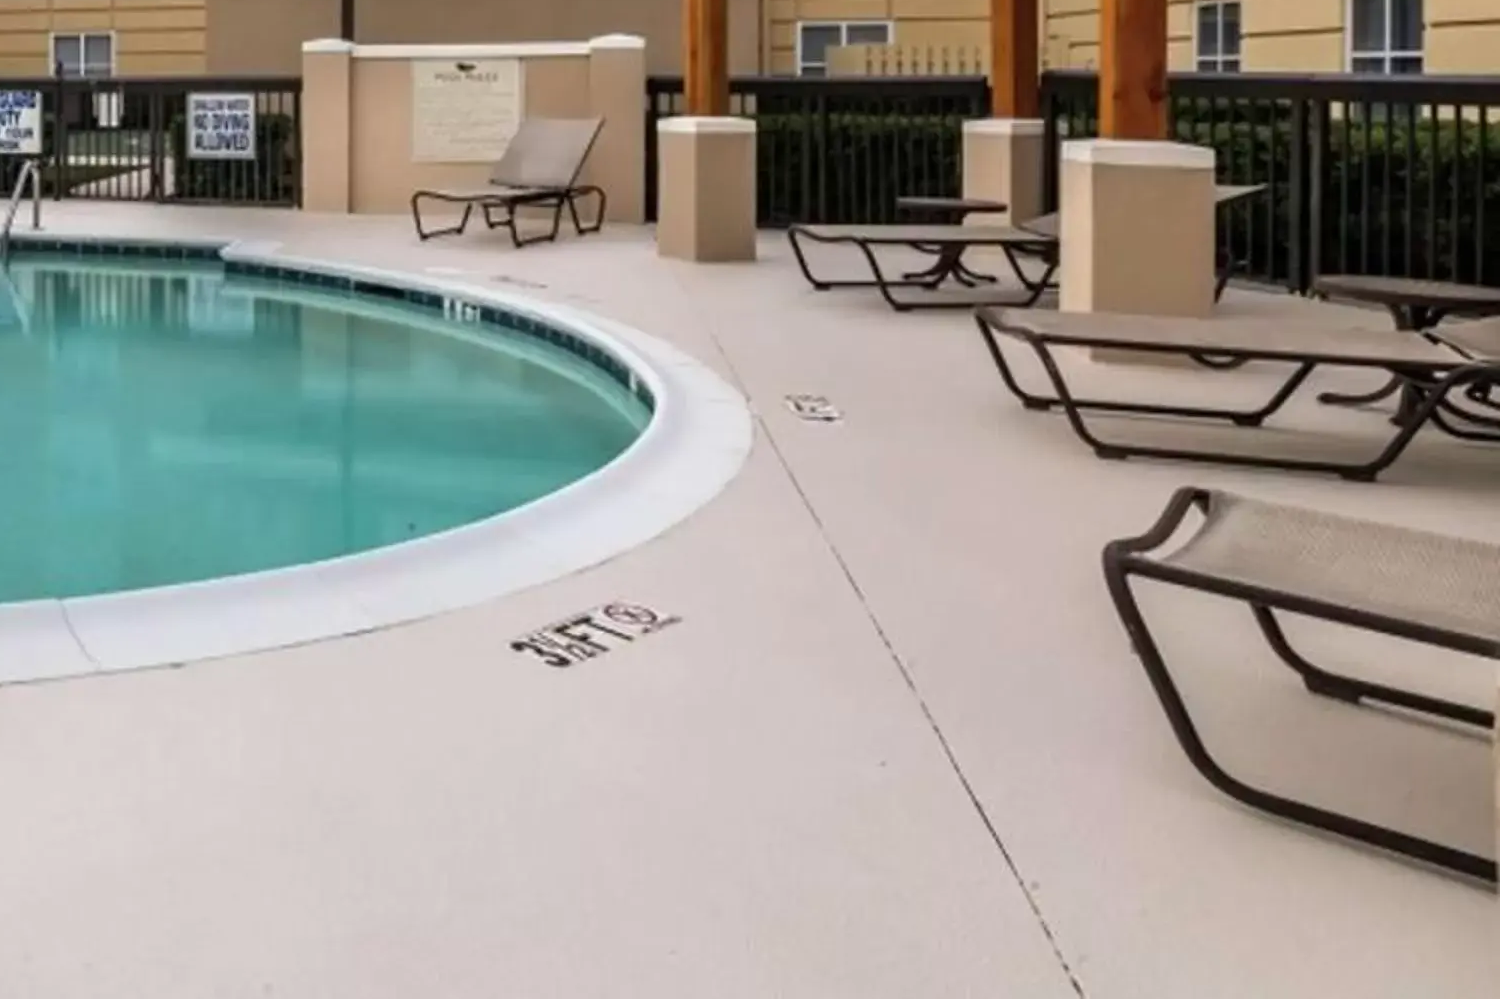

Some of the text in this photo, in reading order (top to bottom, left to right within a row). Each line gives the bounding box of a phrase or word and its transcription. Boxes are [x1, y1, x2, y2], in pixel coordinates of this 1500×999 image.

[194, 112, 250, 131] NO DIVING
[5, 127, 34, 139] YOUR
[195, 132, 250, 151] ALLOWED
